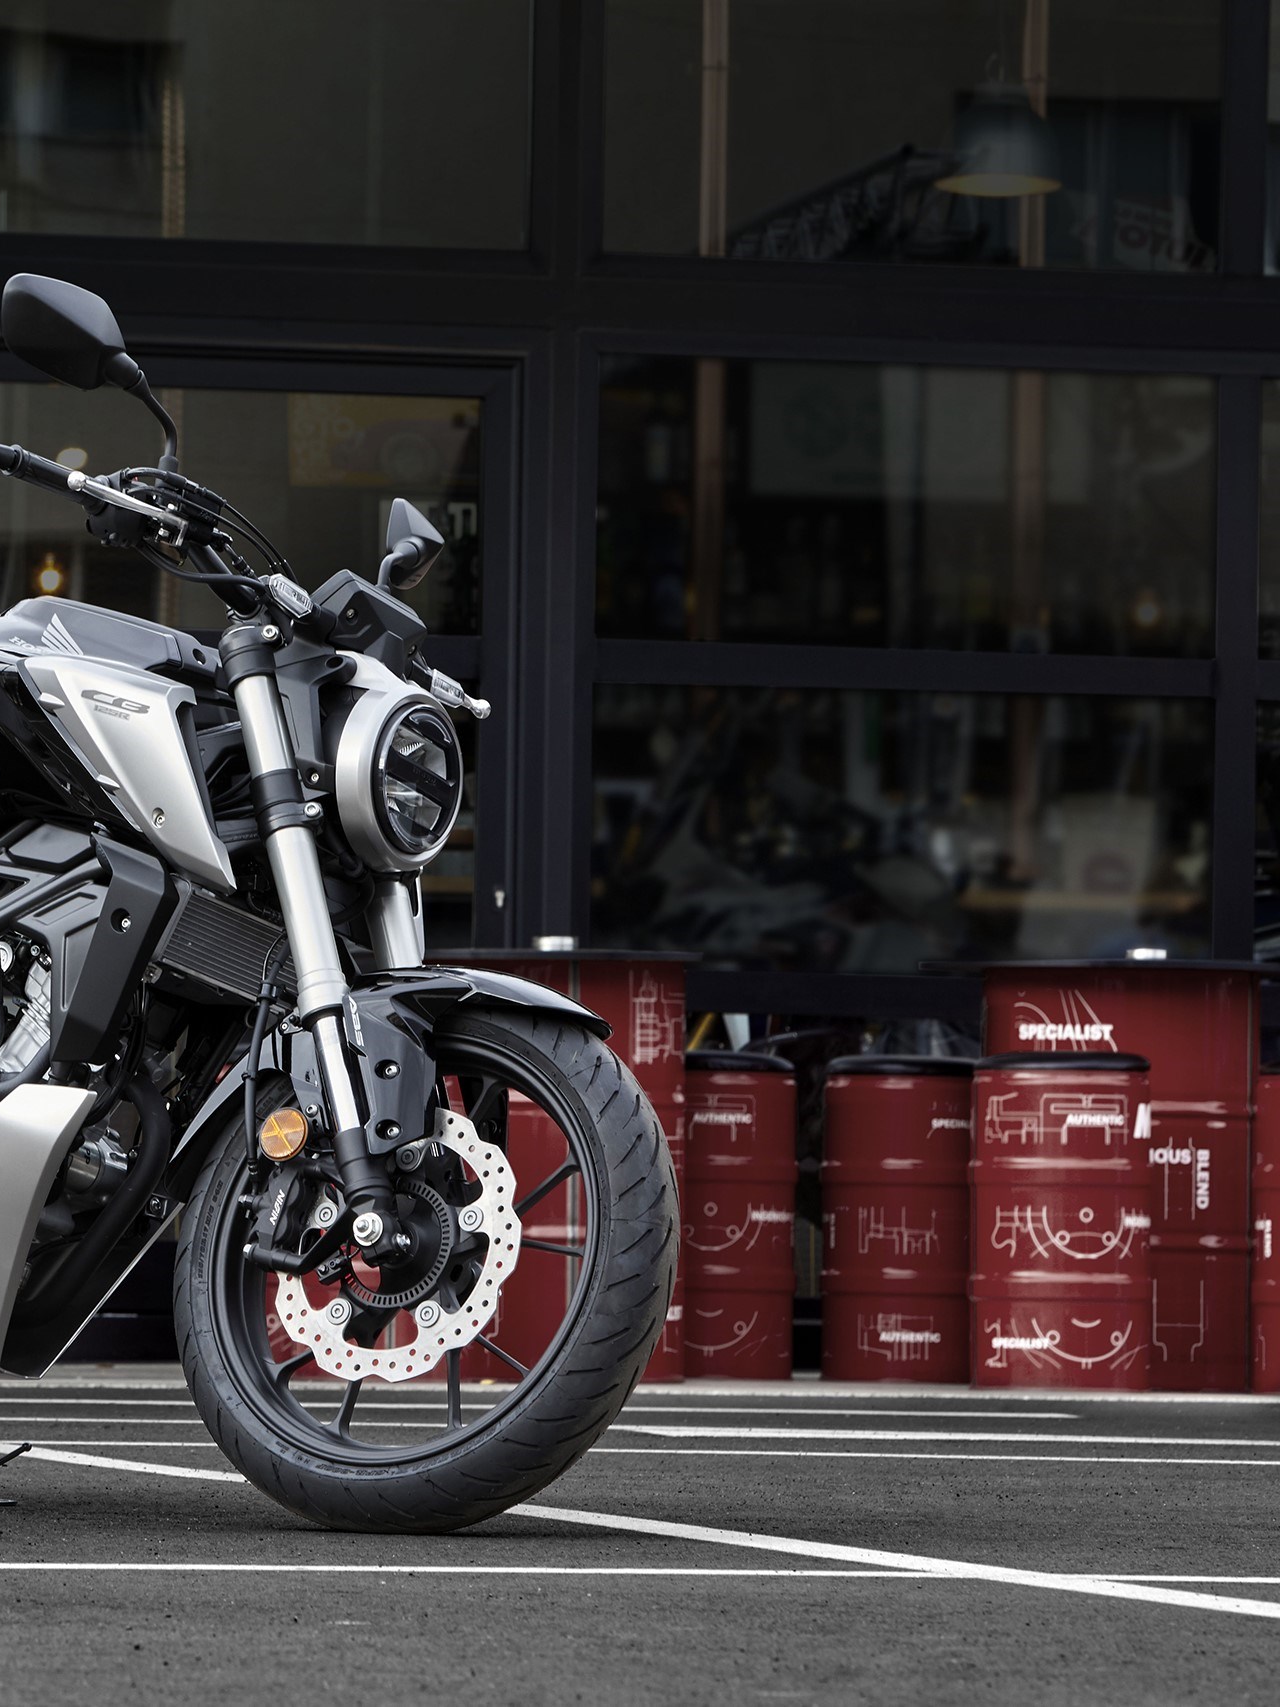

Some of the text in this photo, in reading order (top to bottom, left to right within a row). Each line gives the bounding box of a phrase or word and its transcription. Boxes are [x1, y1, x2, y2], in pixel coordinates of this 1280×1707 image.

[348, 994, 365, 1047] ABS
[1018, 1022, 1114, 1041] SPECIALIST
[693, 1111, 753, 1125] AUTHENTIC
[1065, 1113, 1125, 1127] AUTHENTIC
[1196, 1149, 1211, 1211] BLEND
[269, 1188, 286, 1226] NISSIN
[879, 1331, 941, 1344] AUTHENTIC
[991, 1336, 1049, 1350] SPECIALIST
